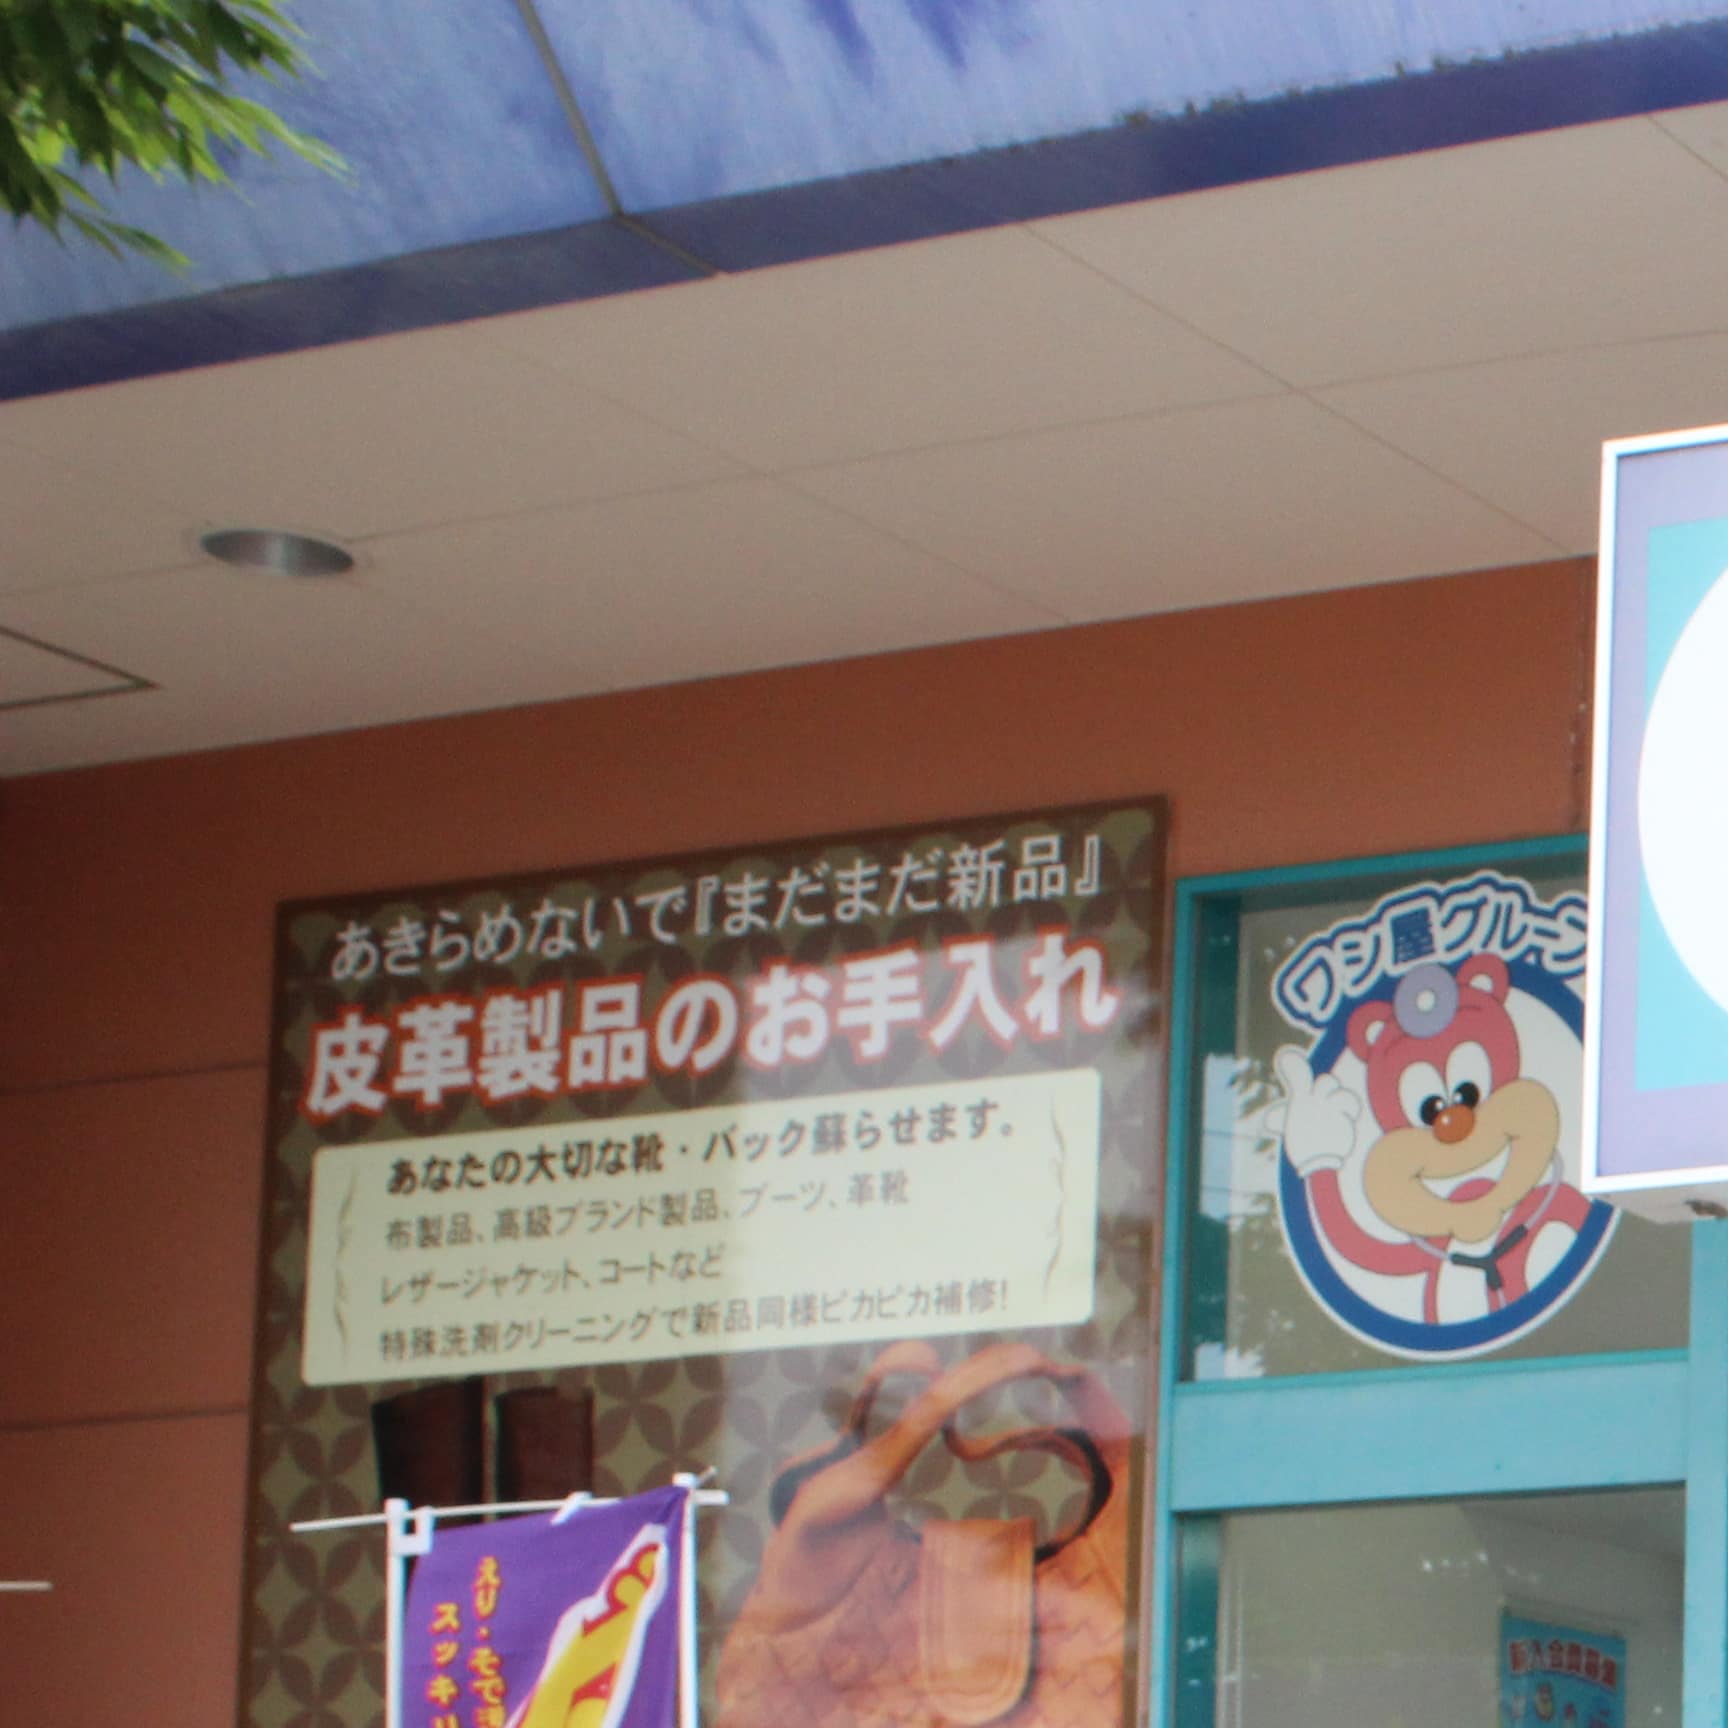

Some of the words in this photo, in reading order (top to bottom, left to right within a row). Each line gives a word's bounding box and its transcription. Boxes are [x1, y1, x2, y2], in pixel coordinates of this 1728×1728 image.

[329, 833, 1104, 981] あきらめないで『まだまだ新品』
[304, 932, 1121, 1119] 皮革製品のお手入れ
[379, 1242, 726, 1306] レザージャケット、コートなど
